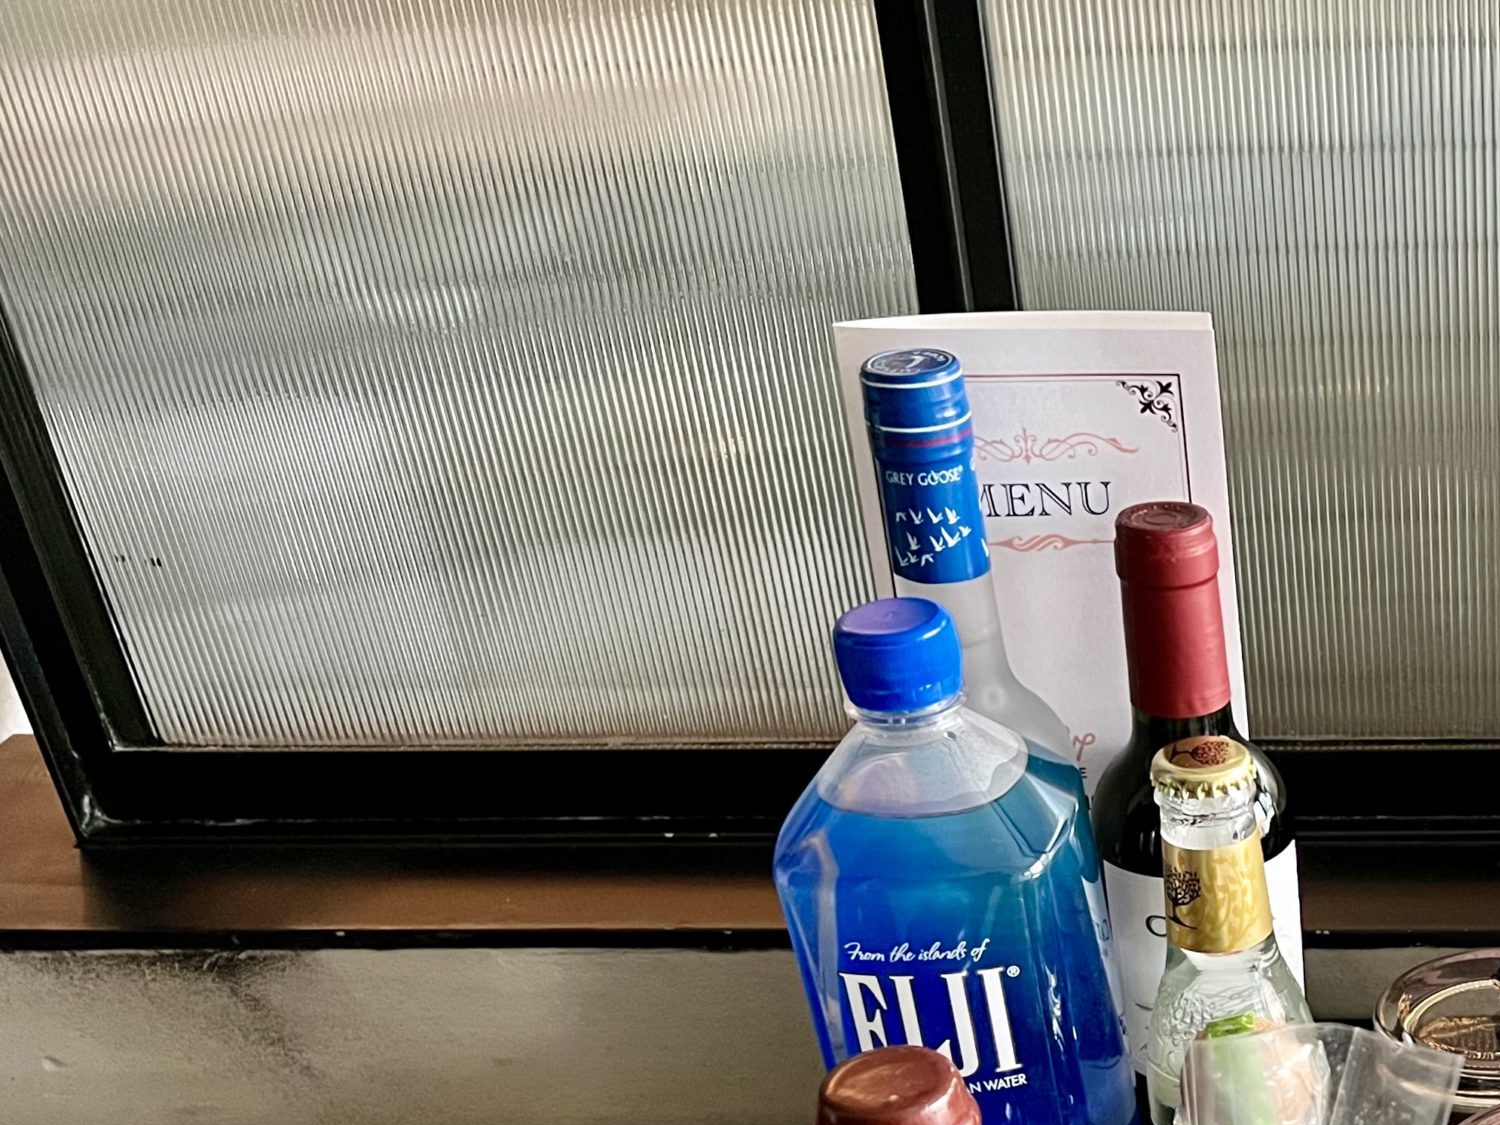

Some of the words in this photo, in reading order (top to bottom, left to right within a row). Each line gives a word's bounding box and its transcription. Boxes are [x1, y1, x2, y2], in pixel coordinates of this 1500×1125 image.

[885, 469, 913, 486] GREY
[918, 465, 963, 486] GOOSE
[844, 941, 885, 961] From
[889, 942, 915, 962] the
[918, 941, 967, 961] islands
[971, 938, 990, 962] of
[839, 965, 1023, 1078] FIJI
[983, 1073, 1027, 1092] WATER
